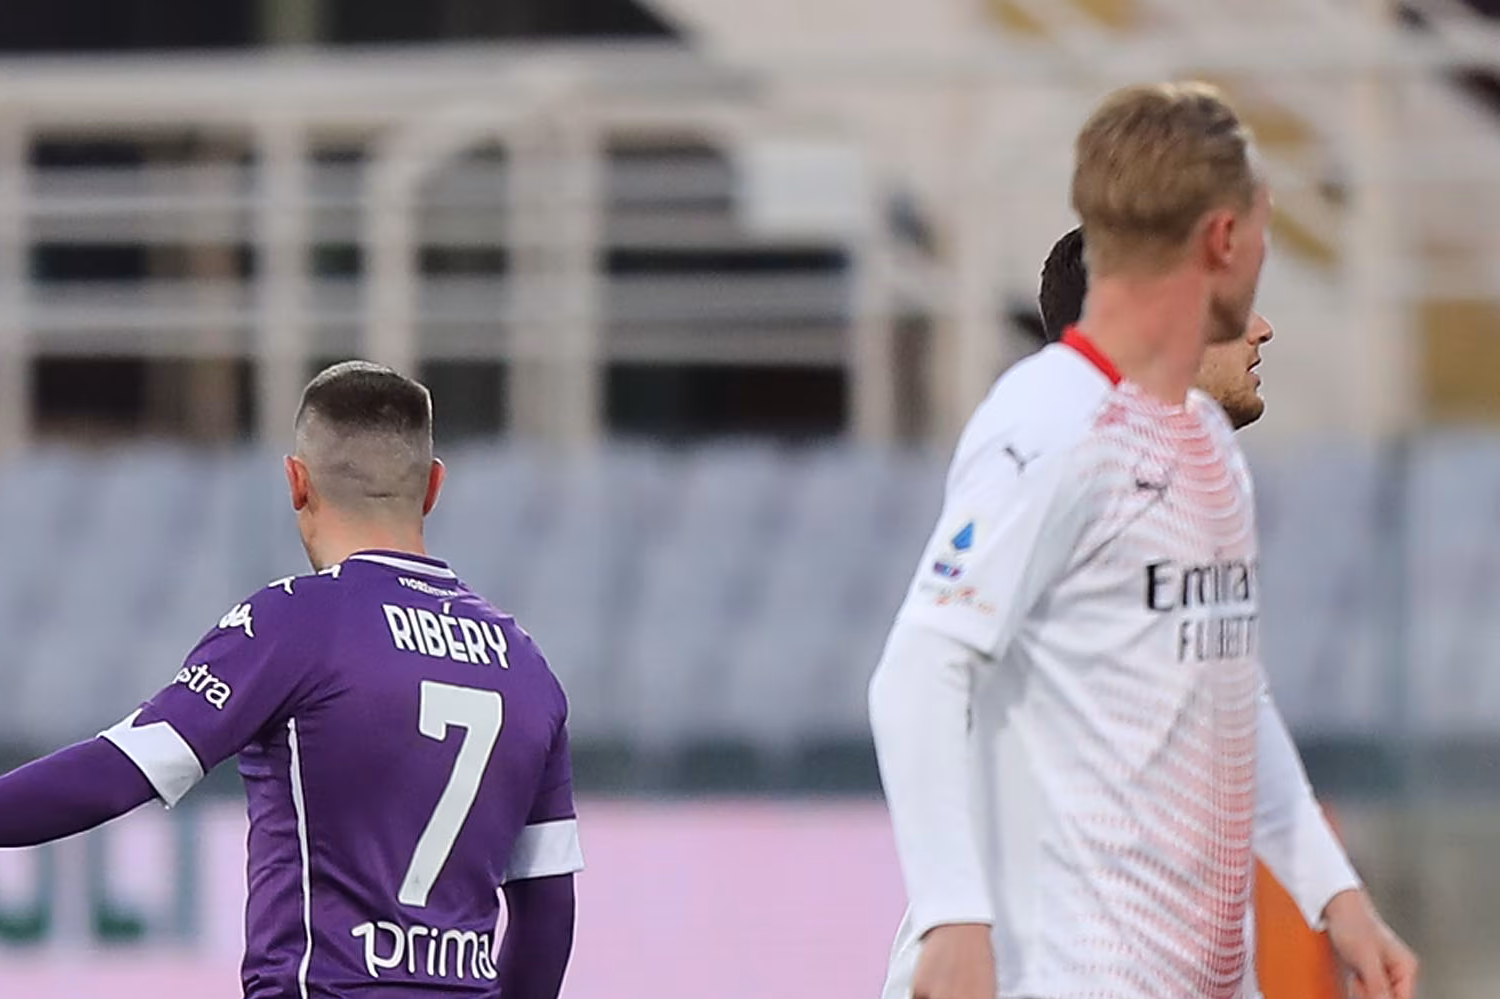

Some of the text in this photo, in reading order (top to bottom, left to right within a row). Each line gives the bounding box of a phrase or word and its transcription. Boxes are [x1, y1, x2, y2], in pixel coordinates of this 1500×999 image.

[382, 601, 509, 669] RIBÉRY
[399, 680, 503, 907] 7
[351, 921, 498, 980] prima
